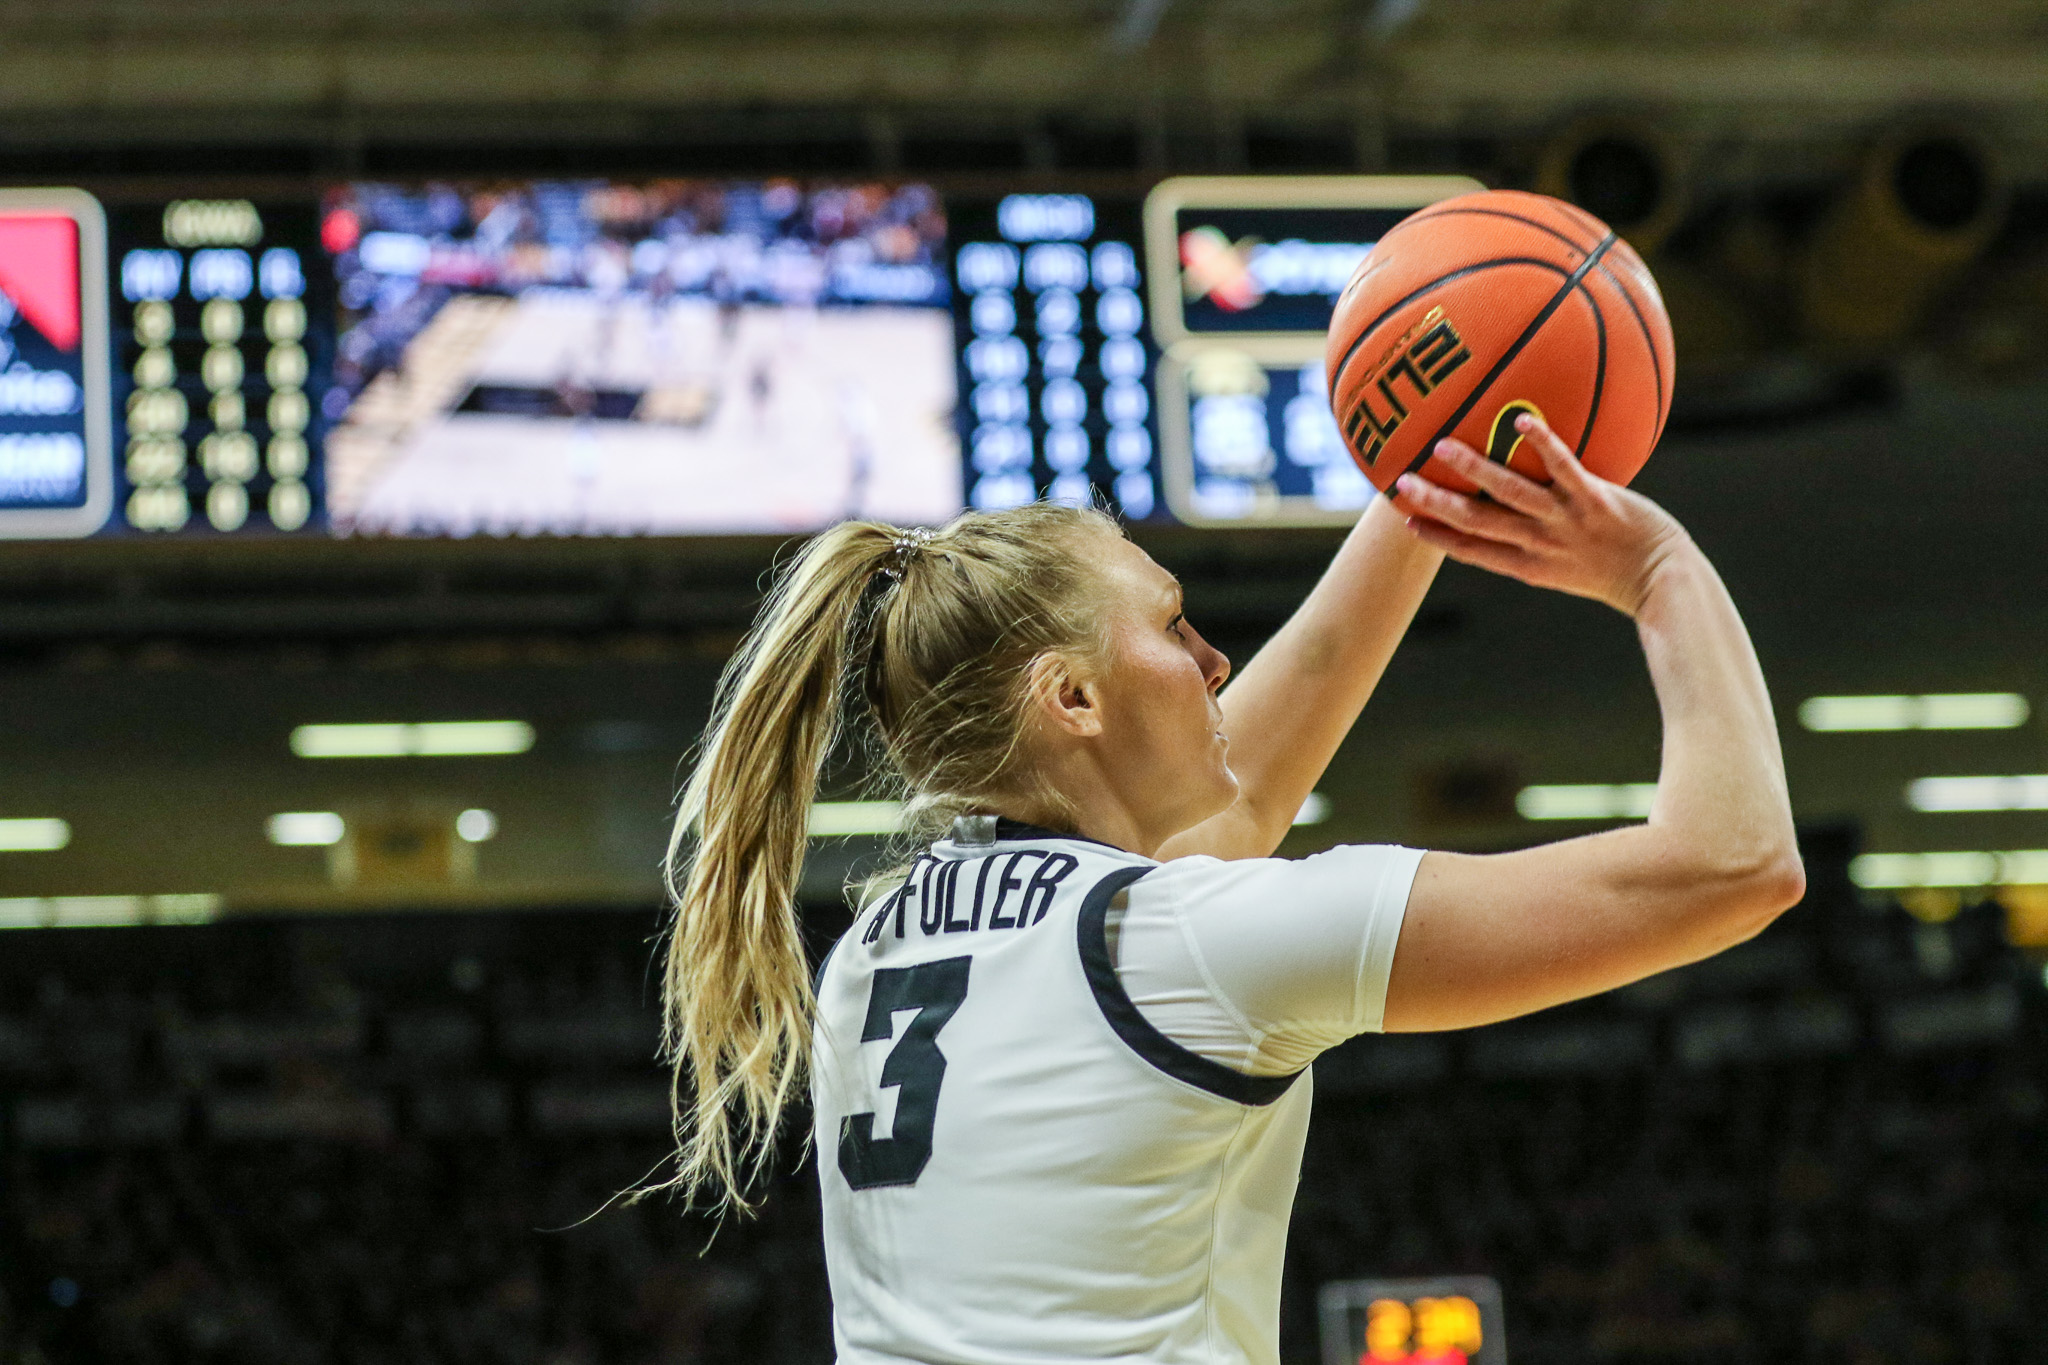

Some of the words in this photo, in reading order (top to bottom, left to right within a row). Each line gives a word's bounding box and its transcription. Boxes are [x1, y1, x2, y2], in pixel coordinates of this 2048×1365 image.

[1346, 318, 1472, 468] ELITE
[861, 849, 1079, 944] AFOLTER
[838, 955, 973, 1191] 3
